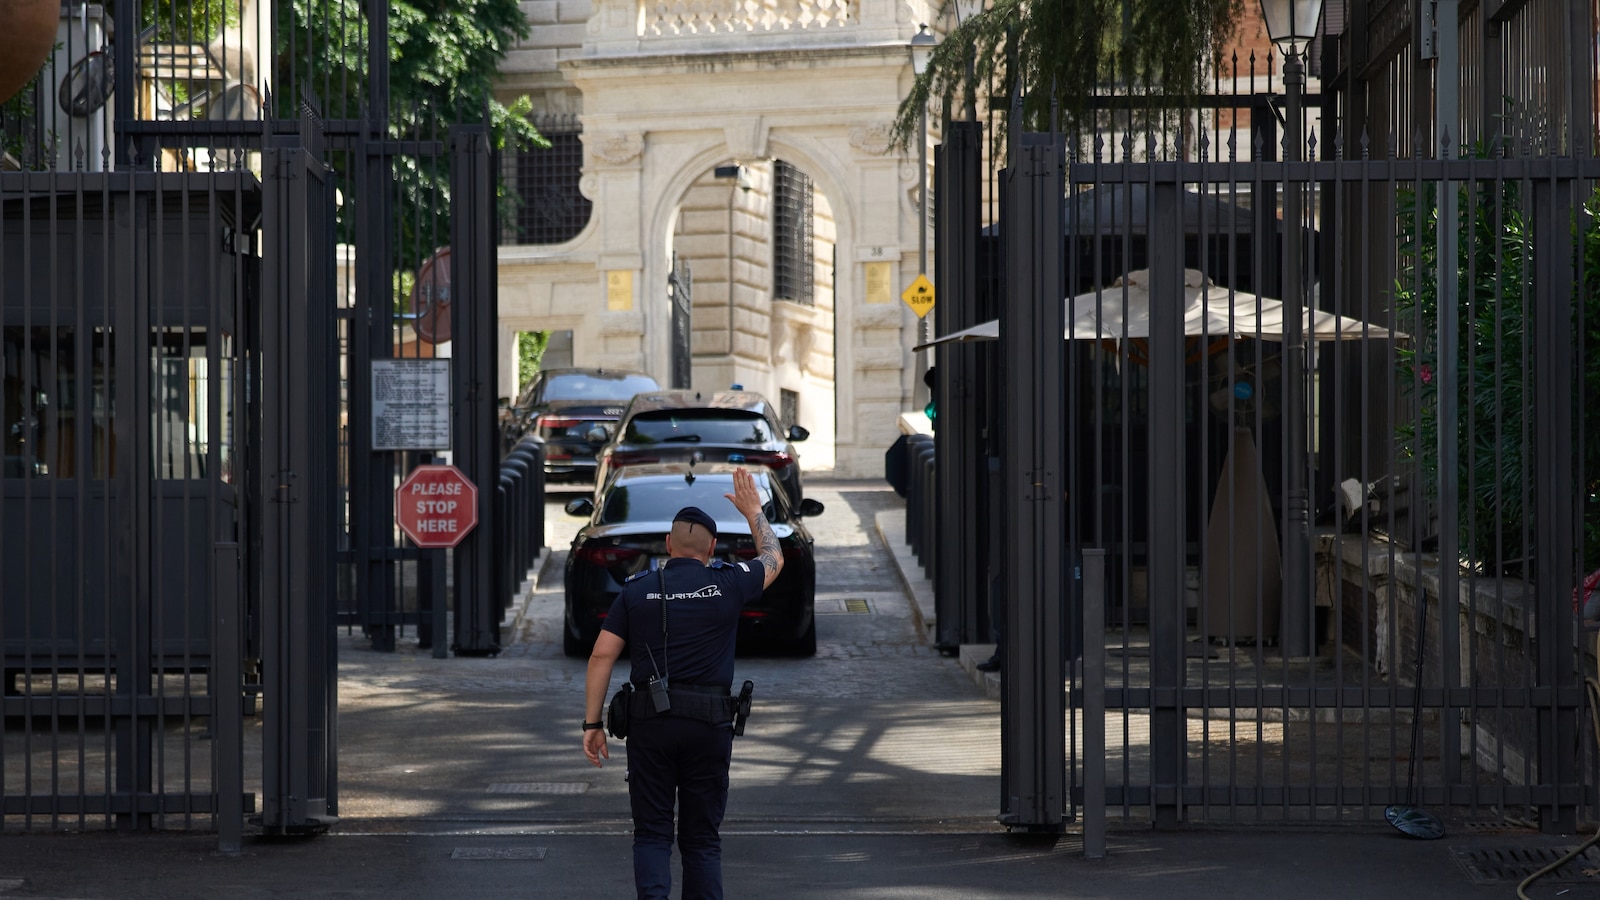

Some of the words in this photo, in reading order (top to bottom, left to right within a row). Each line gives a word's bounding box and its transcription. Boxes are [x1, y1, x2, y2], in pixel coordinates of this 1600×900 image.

[871, 247, 883, 257] 38
[911, 296, 933, 305] SLOW
[412, 483, 462, 496] PLEASE
[416, 501, 457, 514] STOP
[417, 520, 457, 533] HERE
